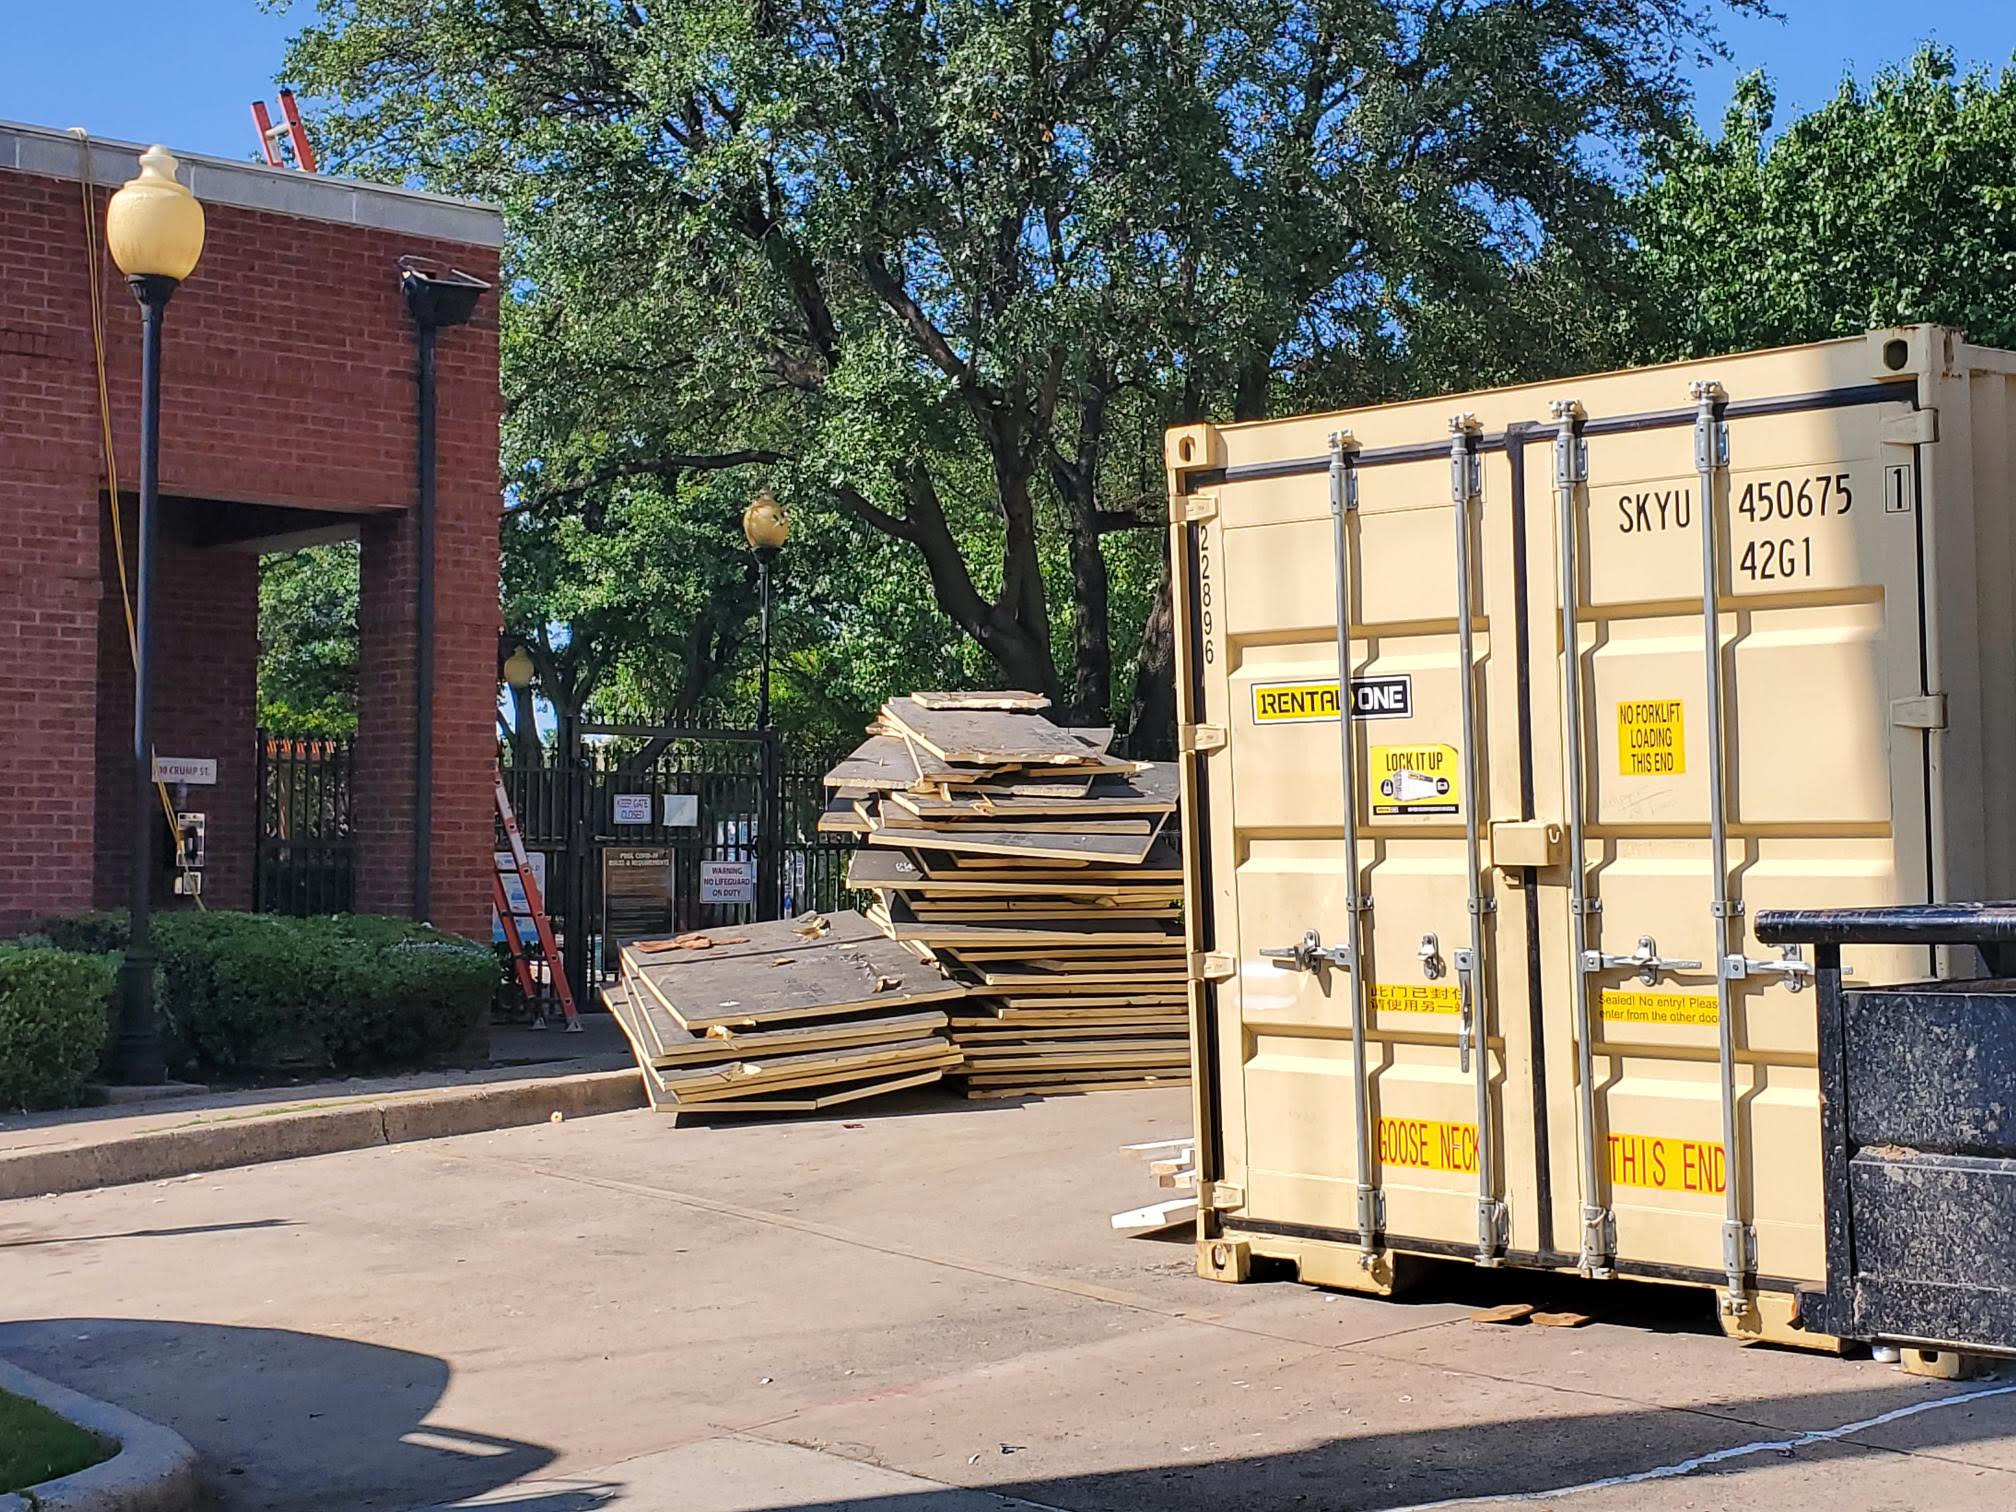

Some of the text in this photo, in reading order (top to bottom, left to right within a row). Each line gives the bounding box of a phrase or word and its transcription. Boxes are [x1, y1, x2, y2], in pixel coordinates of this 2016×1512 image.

[1619, 489, 1690, 533] SKYU
[1739, 474, 1852, 522] 450675
[1740, 537, 1811, 580] 42G1
[1200, 525, 1214, 664] 22896
[1358, 685, 1405, 710] ONE
[1620, 703, 1680, 724] NO FORKLIFT
[1630, 728, 1672, 748] LOADING
[169, 766, 198, 776] CRUMP
[1386, 752, 1443, 771] LOCK IT UP
[1631, 752, 1673, 773] THIS END
[633, 799, 648, 808] GATE
[621, 810, 644, 819] CLOSED
[712, 867, 743, 875] WARNING
[703, 878, 750, 886] NO LIFEGUARD
[1598, 994, 1635, 1006] Sealed!
[1639, 996, 1653, 1006] No
[1689, 998, 1719, 1009] Pleas
[1600, 1009, 1719, 1023] enter from the other doo
[1378, 1119, 1480, 1171] GOOSE NECK
[1607, 1136, 1727, 1192] THIS END
